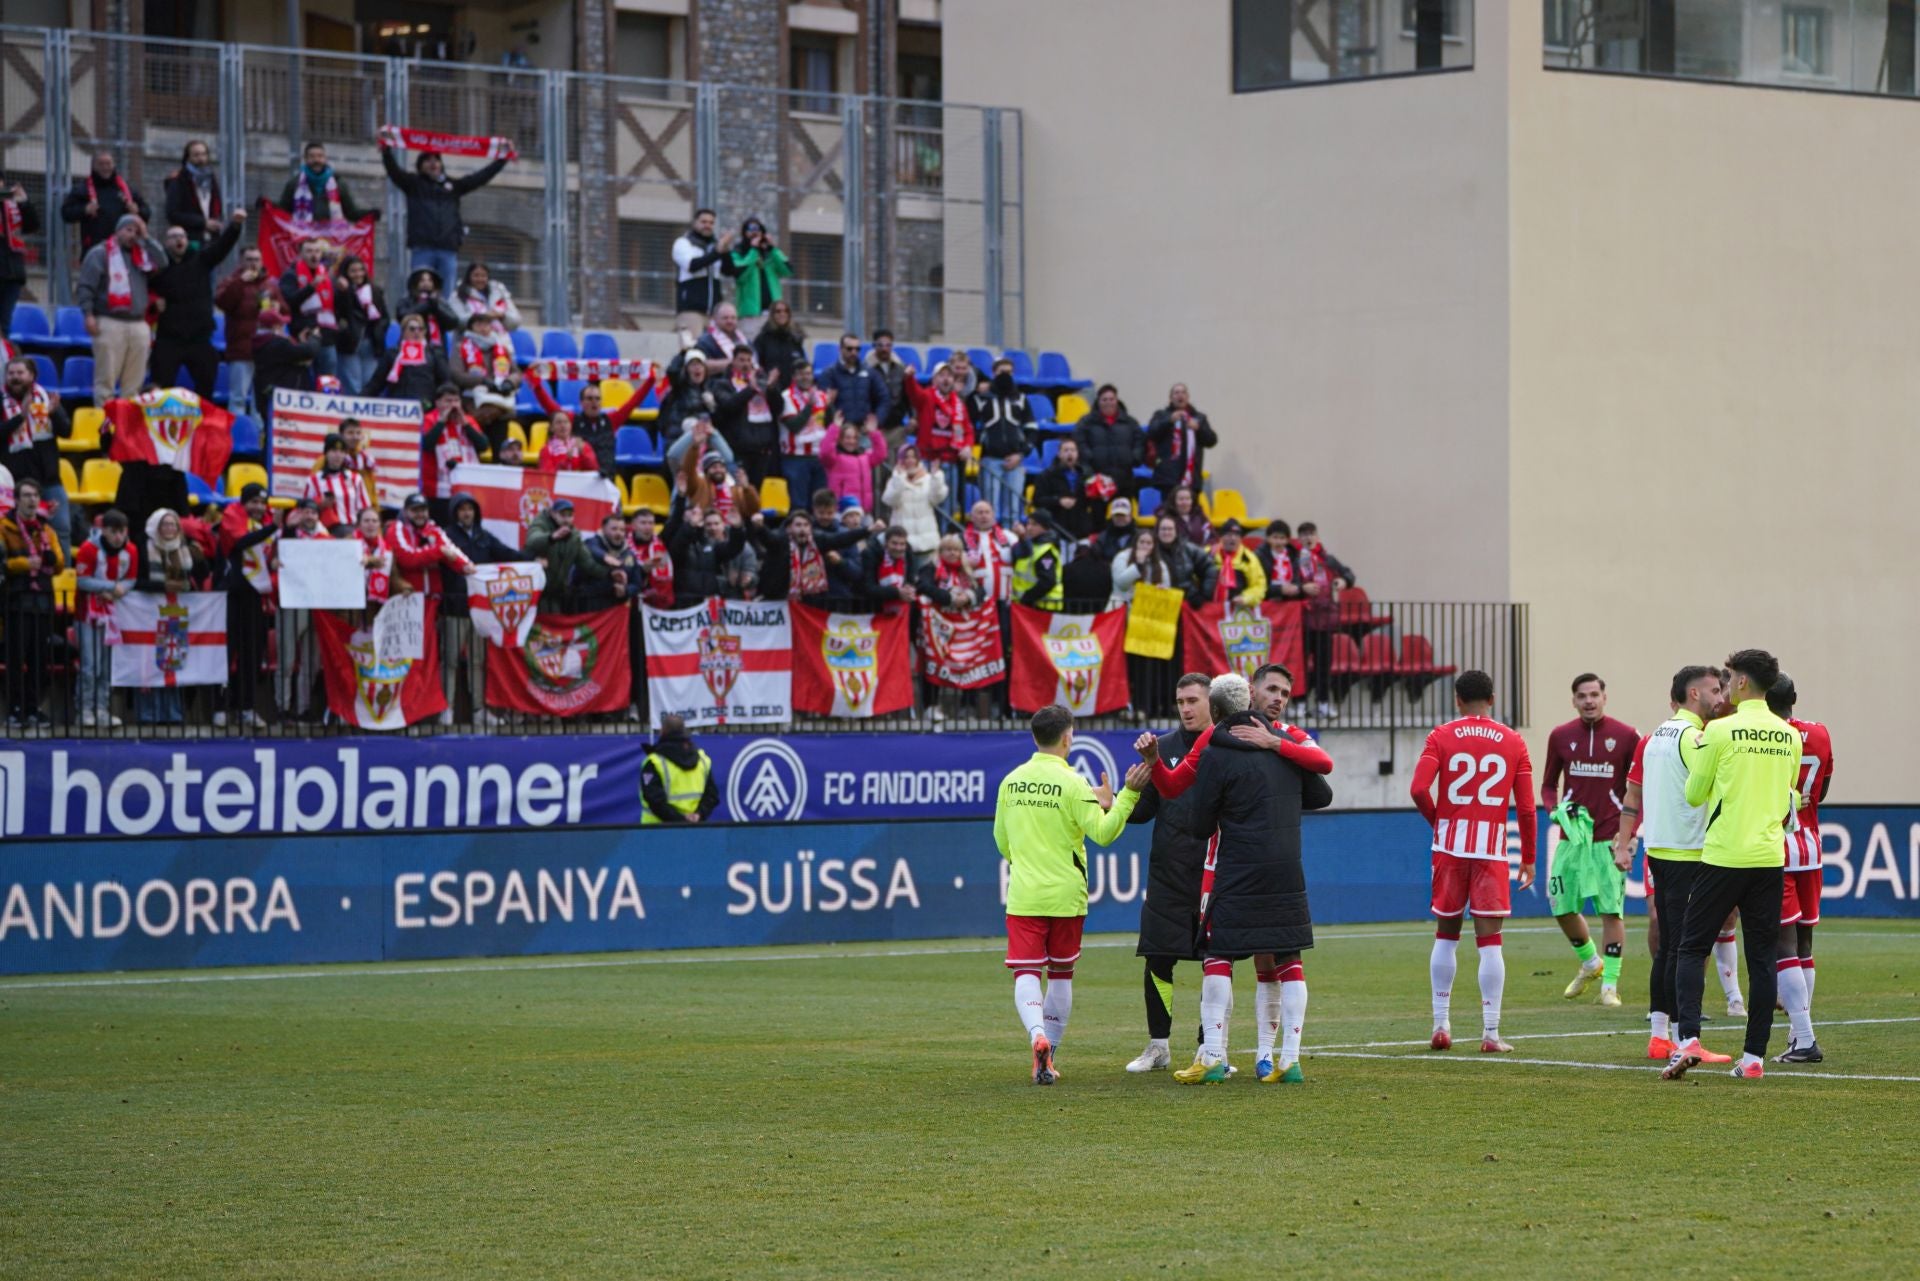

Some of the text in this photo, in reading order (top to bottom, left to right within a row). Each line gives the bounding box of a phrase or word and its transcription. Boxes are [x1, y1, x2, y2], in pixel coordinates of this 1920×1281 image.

[276, 391, 421, 419] U.D. ALMERIA
[1454, 725, 1504, 743] CHIRINO
[1731, 728, 1793, 745] macron
[1447, 751, 1508, 807] 22
[1569, 760, 1614, 774] Almería
[50, 748, 599, 835] hotelplanner
[824, 770, 985, 805] FC ANDORRA
[1007, 781, 1062, 797] macron
[0, 877, 301, 941] ANDORRA
[395, 866, 646, 928] ESPANYA
[726, 850, 920, 916] SUÏSSA
[1550, 875, 1565, 896] 31
